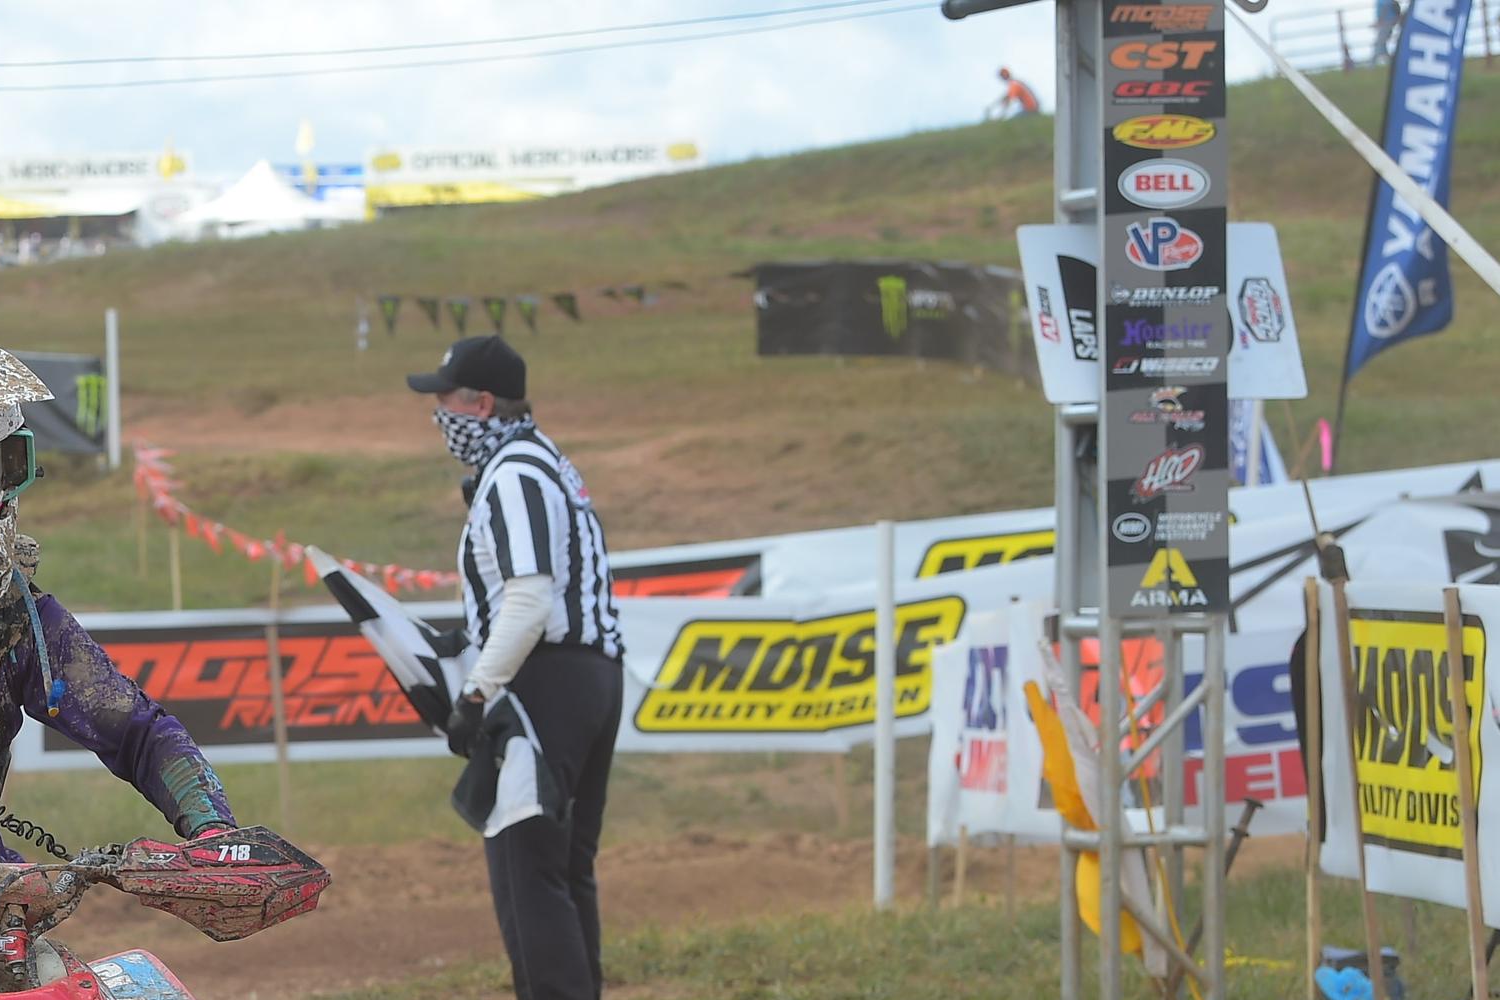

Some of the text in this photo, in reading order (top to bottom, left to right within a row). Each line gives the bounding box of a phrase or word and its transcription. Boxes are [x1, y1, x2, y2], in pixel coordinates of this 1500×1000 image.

[1110, 41, 1217, 70] CST
[1115, 81, 1214, 96] GBC
[1135, 175, 1194, 191] BELL
[1131, 221, 1178, 265] VP
[1132, 287, 1219, 299] DUNLOP
[1130, 589, 1209, 608] ARMA
[103, 635, 412, 701] MOOS
[220, 690, 430, 730] RACING
[654, 703, 784, 719] UTILITY
[1353, 646, 1476, 772] MOOS
[218, 844, 250, 861] 718
